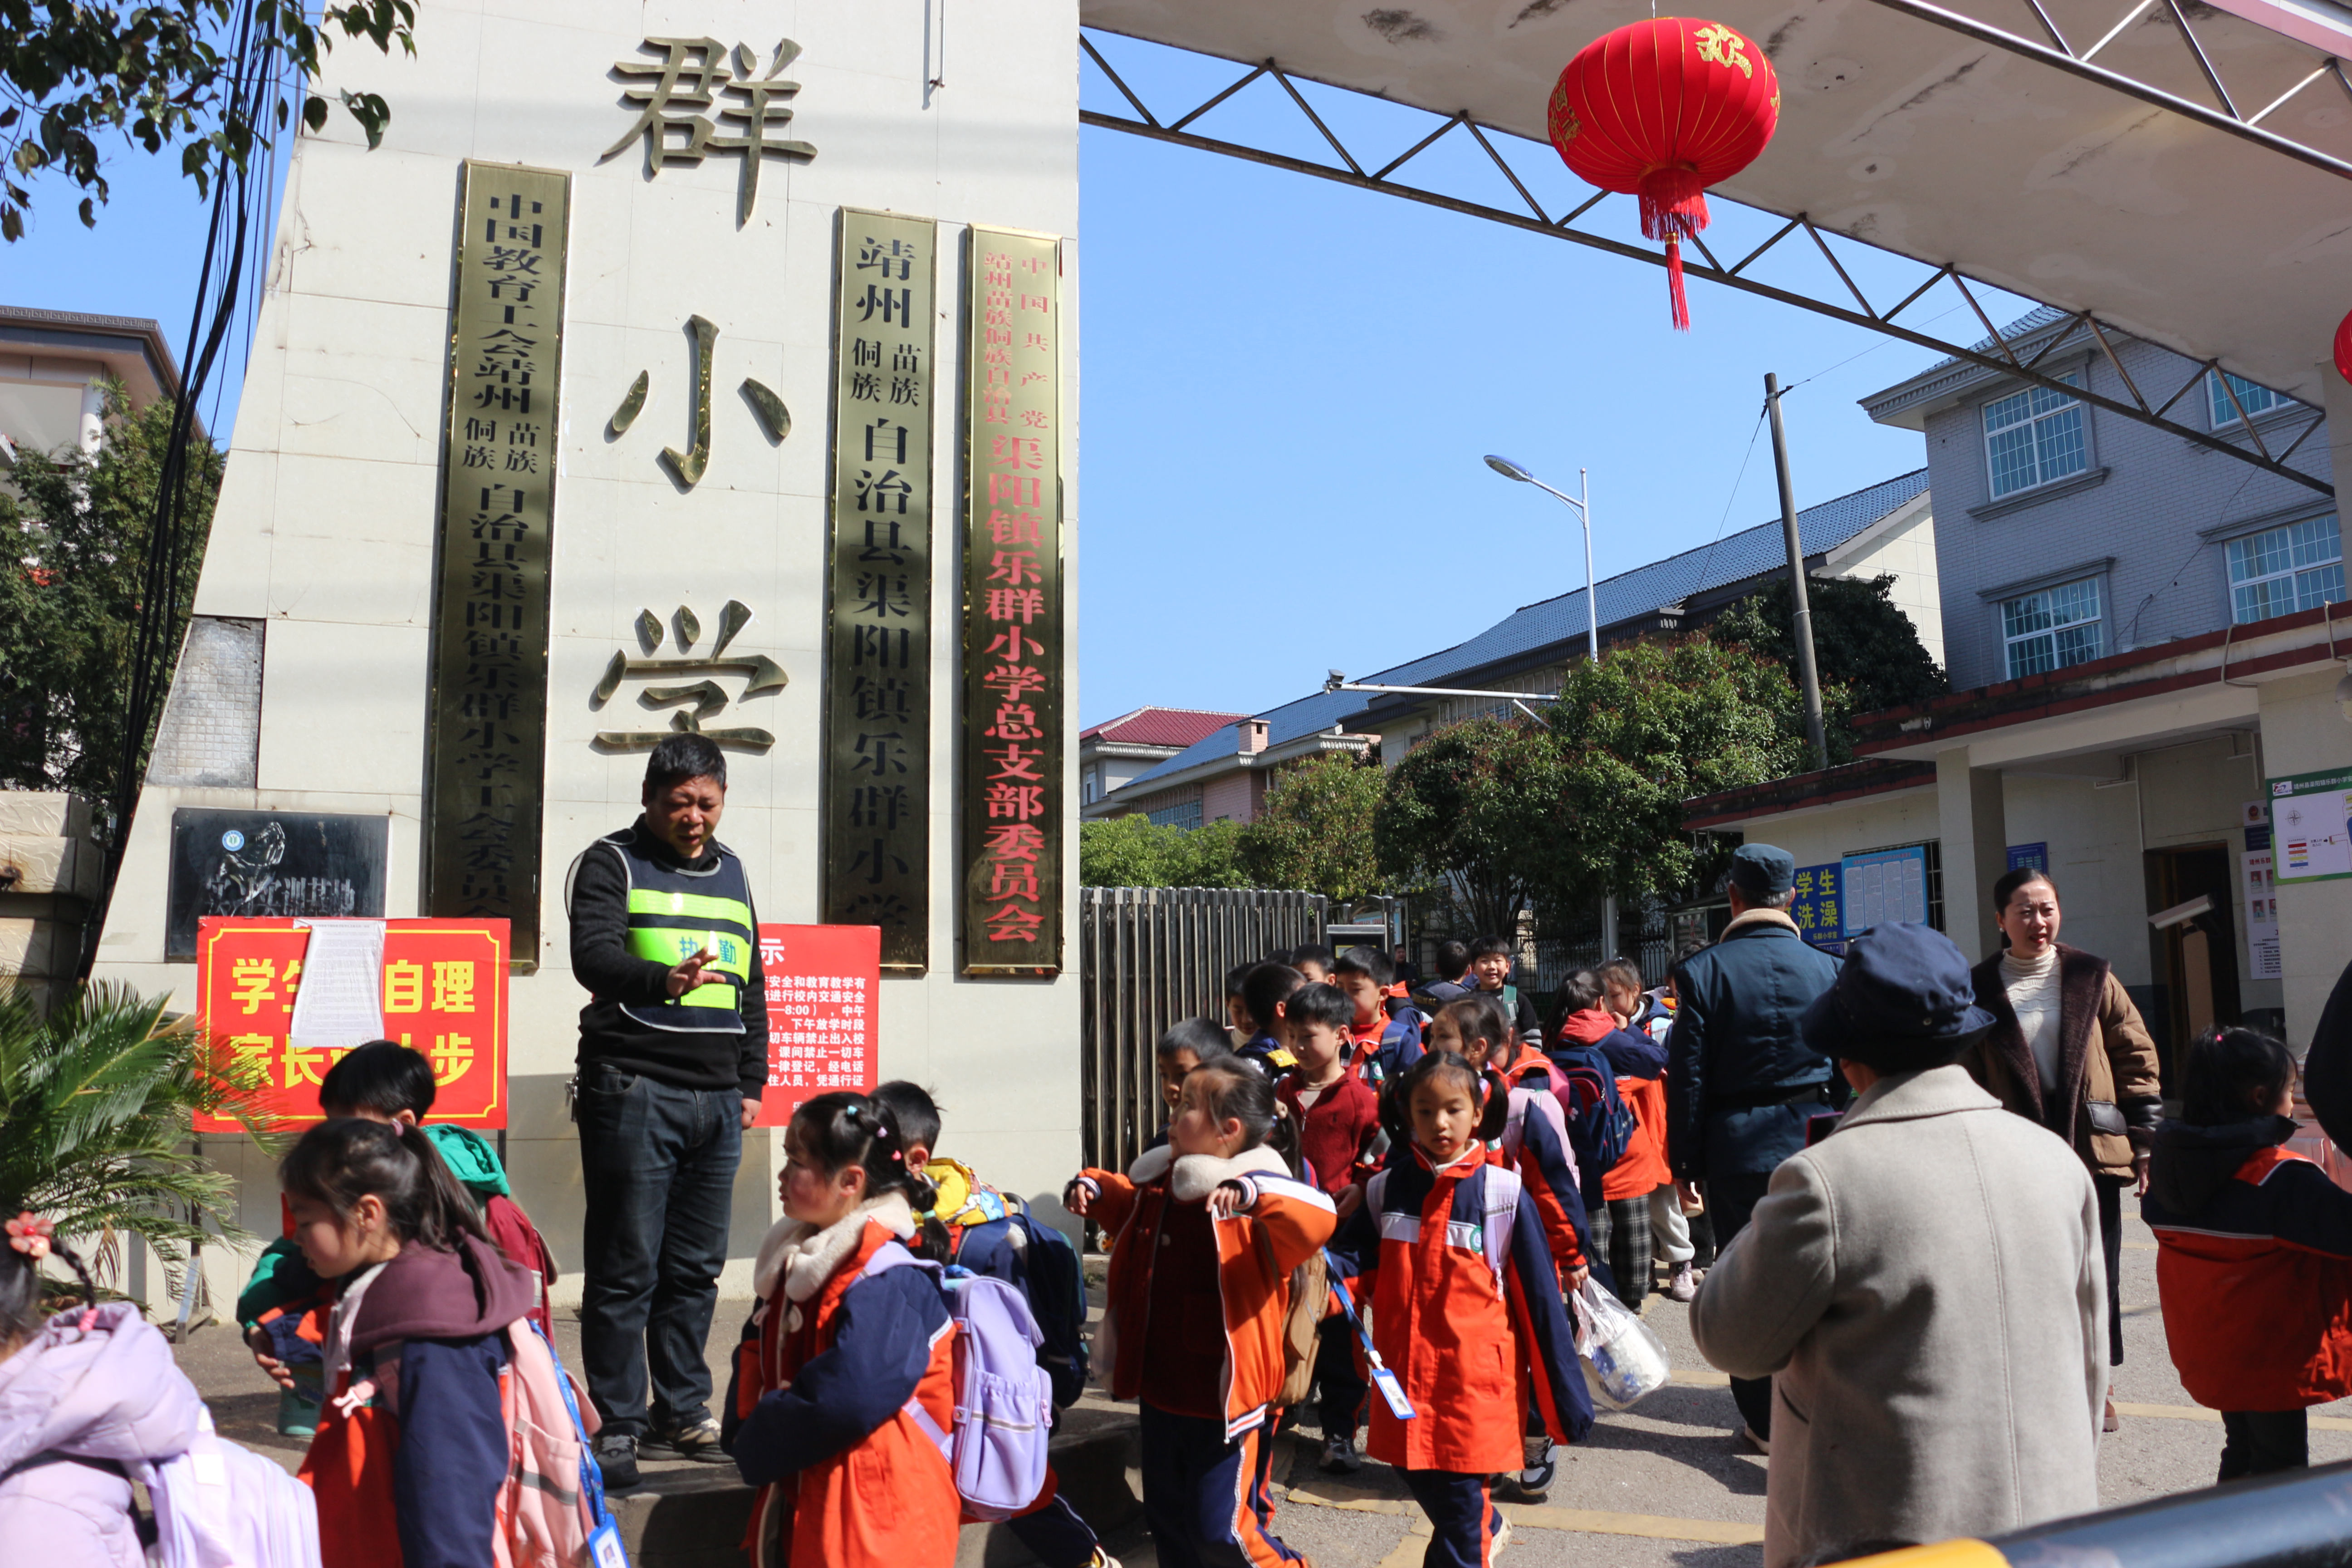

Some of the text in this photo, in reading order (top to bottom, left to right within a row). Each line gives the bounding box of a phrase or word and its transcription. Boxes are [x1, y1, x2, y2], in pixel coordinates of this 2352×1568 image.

[473, 194, 544, 414] 中国教育工会靖州
[981, 251, 1013, 426] 靖州苗族侗族自治县
[1019, 256, 1049, 430] 中国共产党
[850, 337, 881, 404] 侗族
[889, 343, 921, 407] 苗族
[461, 416, 495, 471] 侗族
[503, 422, 541, 475] 苗族
[983, 433, 1046, 942] 渠阳镇乐群小学总支部委员会
[1796, 869, 1836, 899] 学生
[231, 959, 475, 1014] 学自理
[765, 975, 866, 989] 安全和教育教学有
[230, 1033, 474, 1089] 家长步
